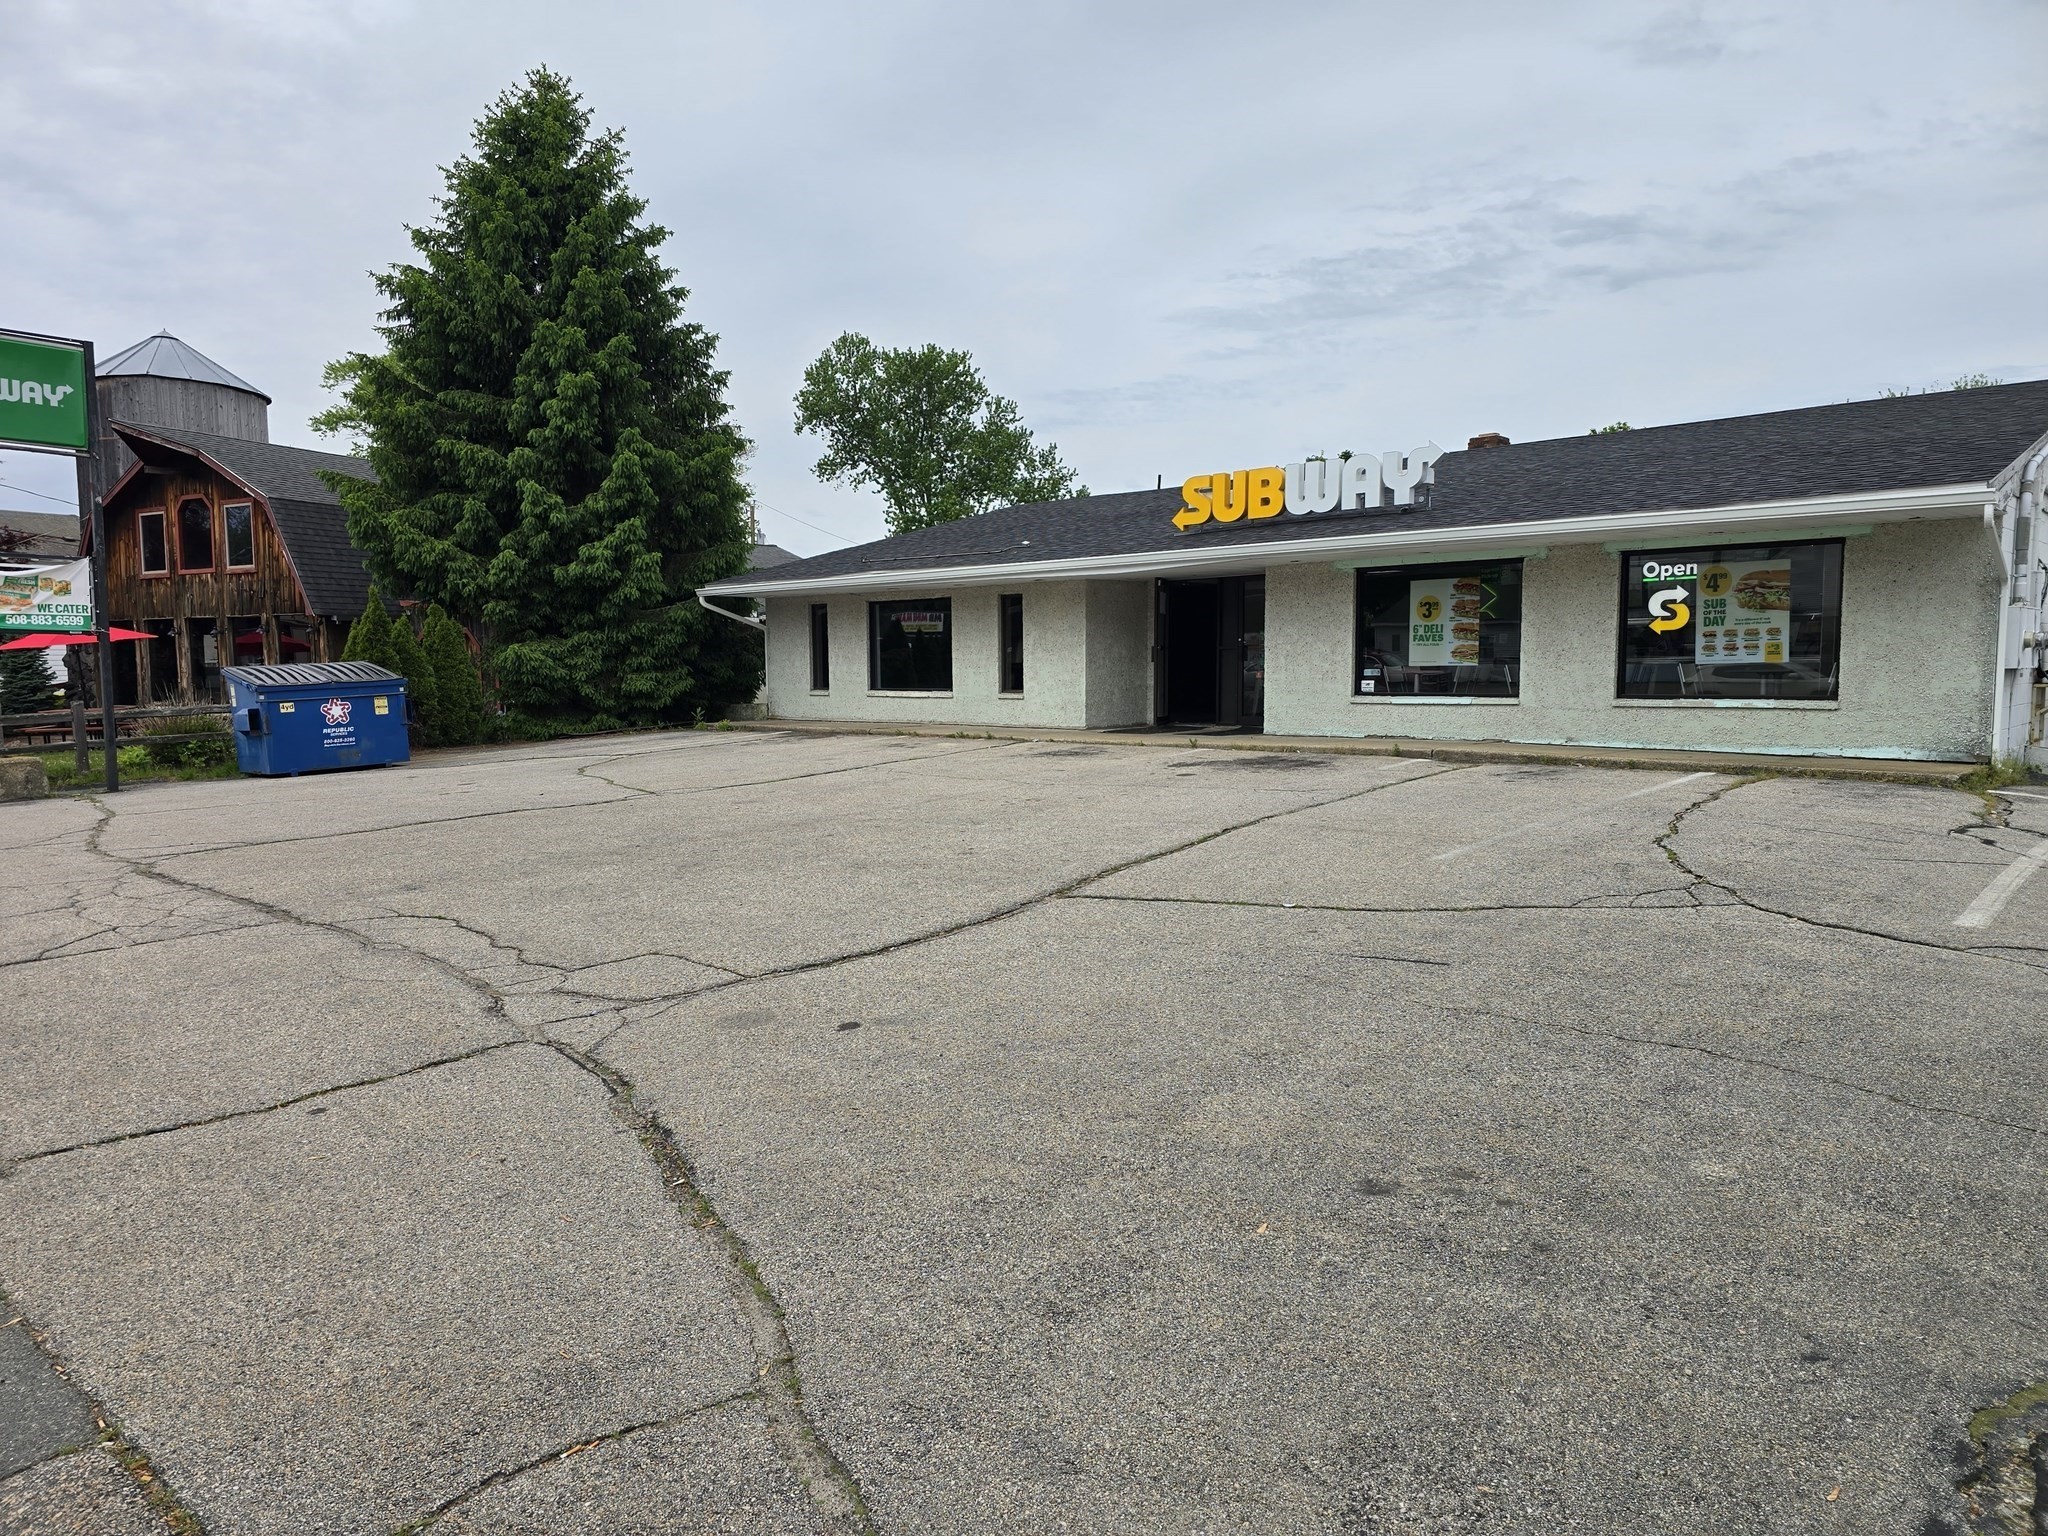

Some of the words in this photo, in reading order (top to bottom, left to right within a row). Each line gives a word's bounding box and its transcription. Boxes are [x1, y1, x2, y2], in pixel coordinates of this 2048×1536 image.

[1171, 440, 1446, 531] SUBWAY
[1642, 561, 1698, 581] Open
[37, 603, 54, 613] WE
[55, 604, 89, 614] CATER
[1703, 598, 1727, 610] SUB
[5, 614, 84, 626] 508-883-6599
[1703, 615, 1727, 627] DAY
[1412, 624, 1422, 634] 6"
[1423, 624, 1444, 633] DELI
[1412, 634, 1444, 642] FAVES
[280, 704, 294, 712] 4yd
[322, 726, 355, 734] REPUBLIC
